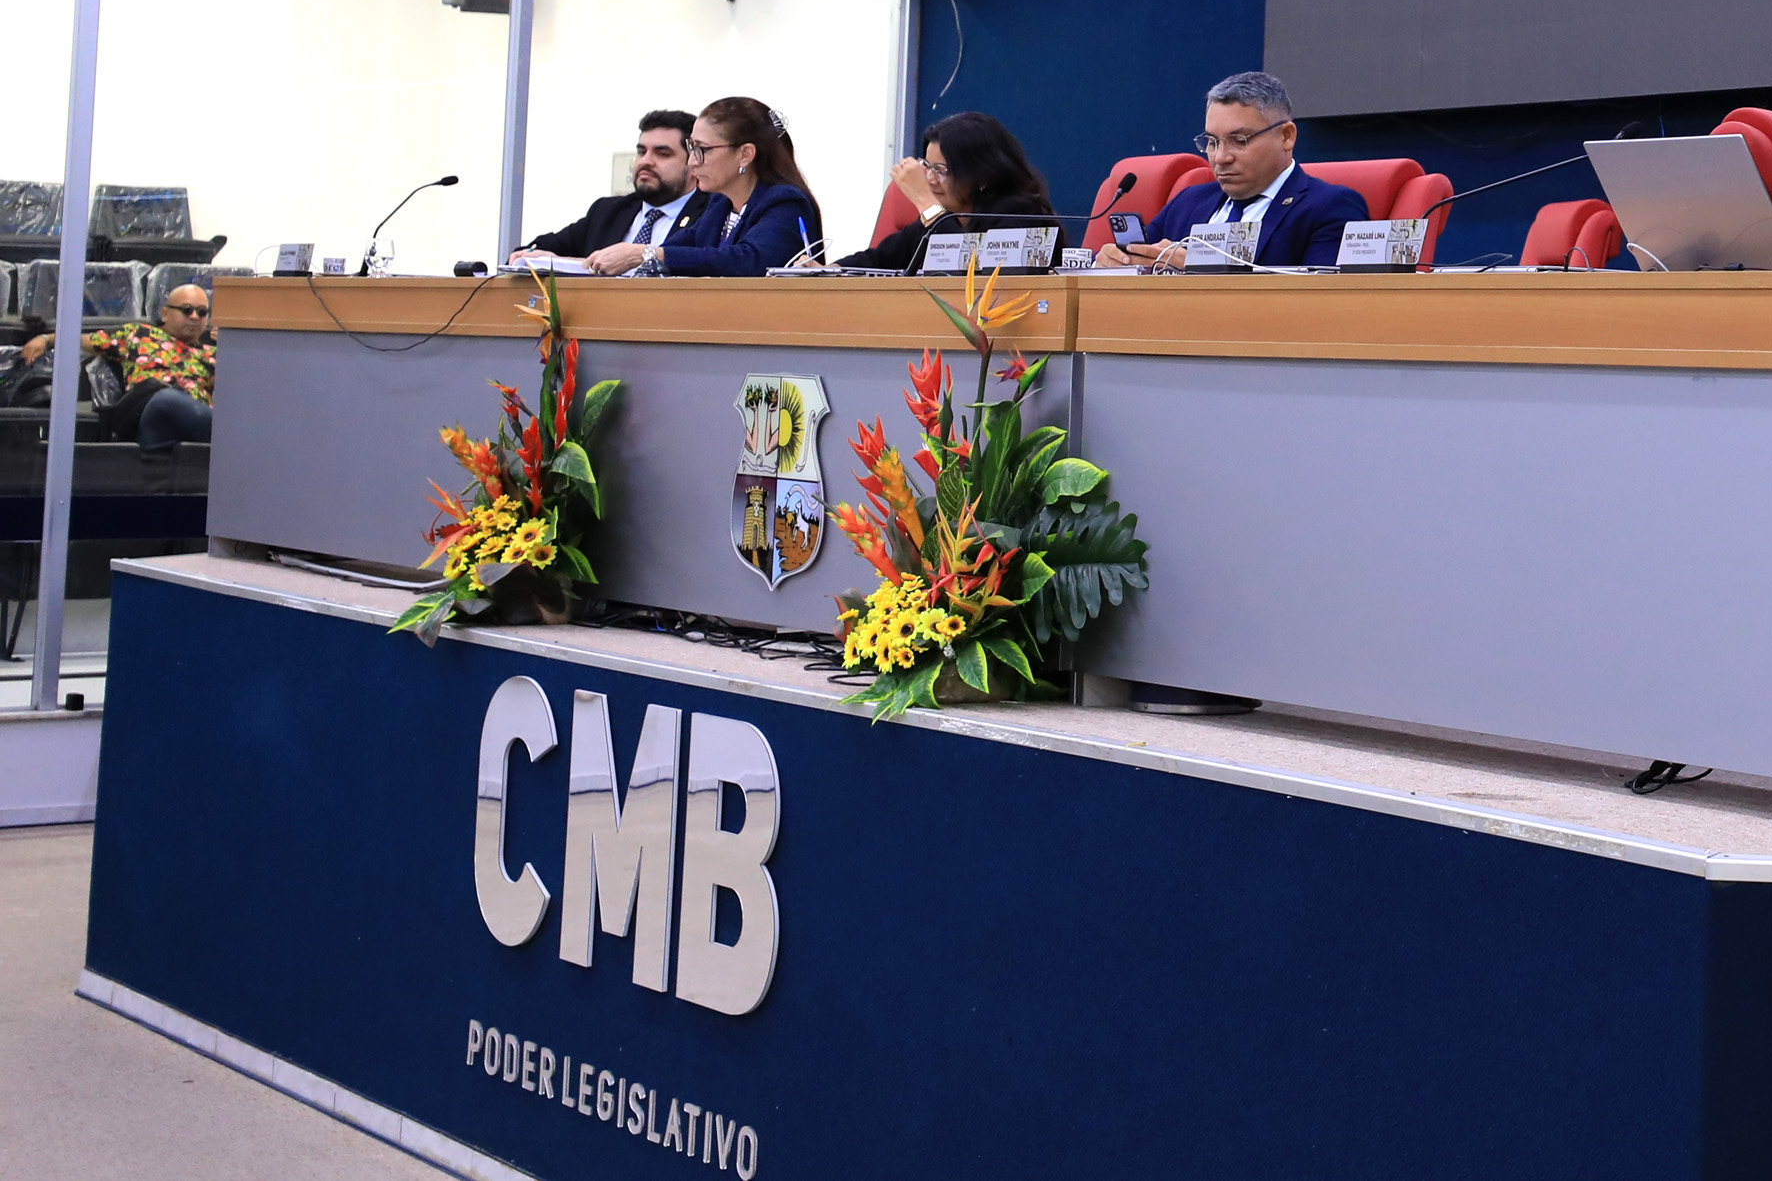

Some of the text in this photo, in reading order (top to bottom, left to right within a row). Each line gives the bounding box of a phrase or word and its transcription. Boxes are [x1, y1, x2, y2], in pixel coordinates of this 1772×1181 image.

[986, 240, 1019, 250] JOHN WAYNE
[473, 674, 782, 1016] CMB
[465, 1018, 759, 1181] PODER LEGISLATIVO
